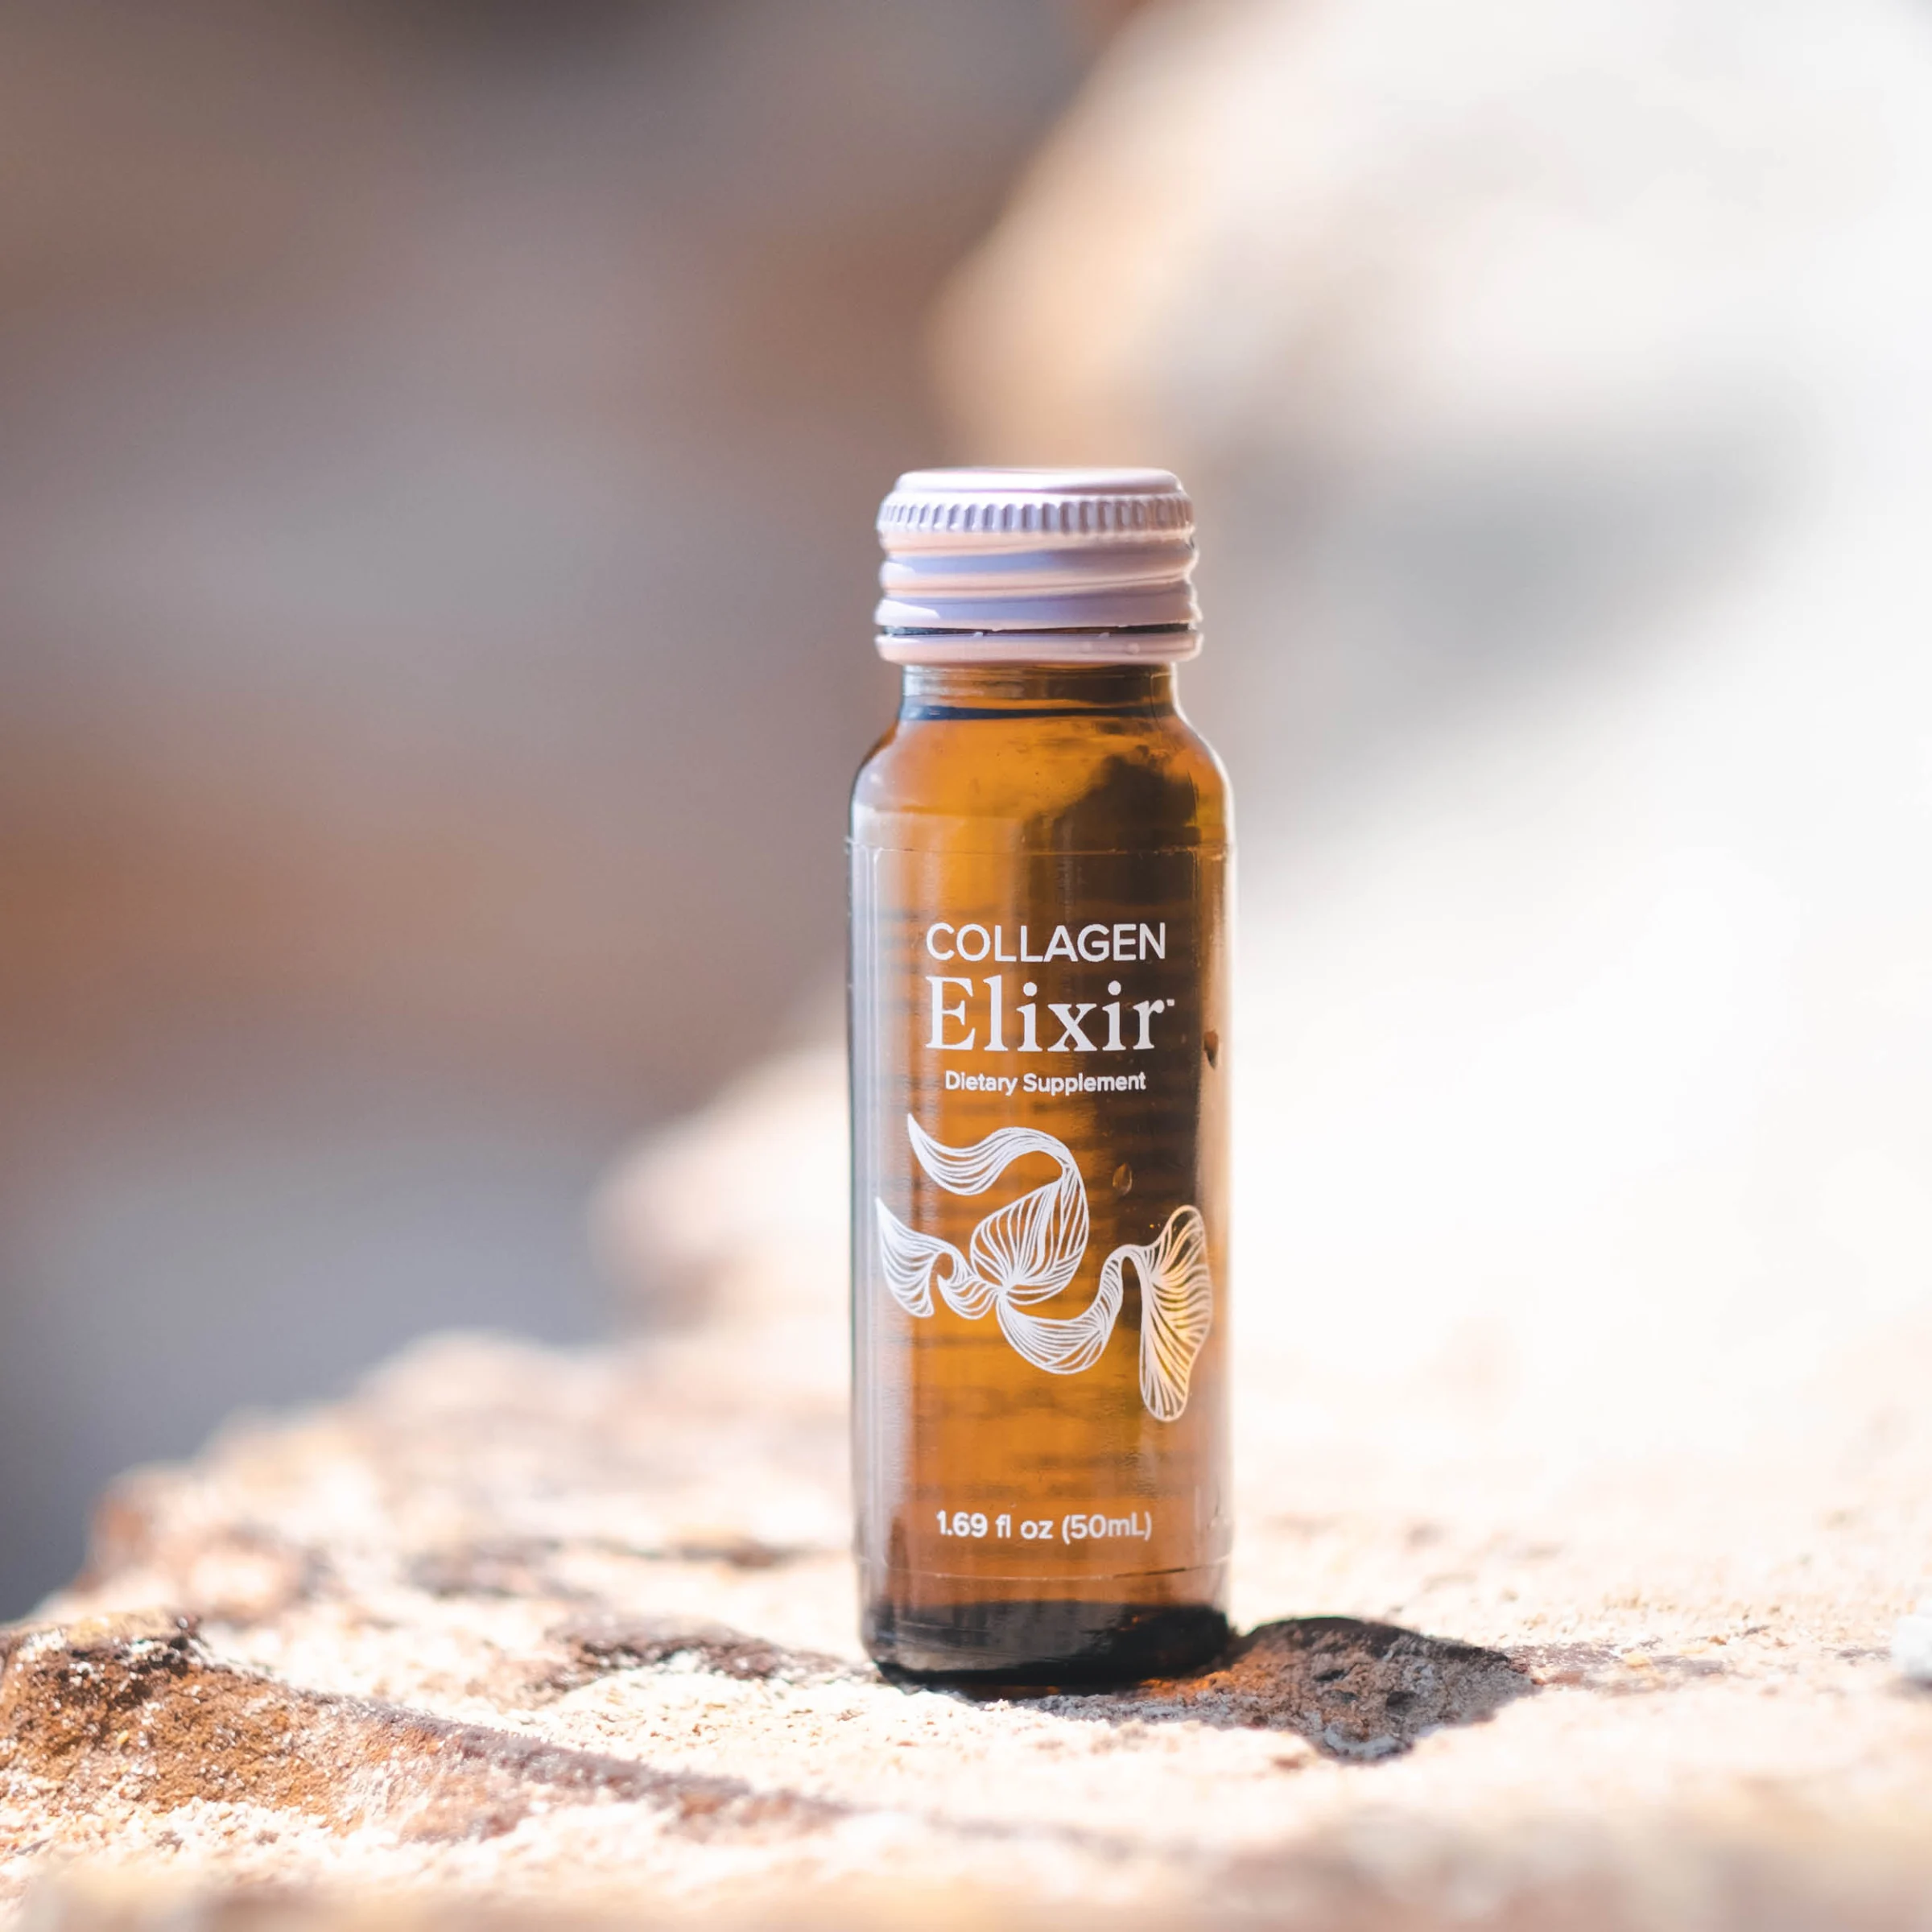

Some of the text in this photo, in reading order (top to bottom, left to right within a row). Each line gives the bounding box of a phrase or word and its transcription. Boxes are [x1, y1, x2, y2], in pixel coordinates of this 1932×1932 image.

[926, 923, 1166, 962] COLLAGEN
[944, 1070, 1146, 1096] Dietary Supplement
[936, 1510, 1152, 1545] 1.69 fl oz (50mL)
